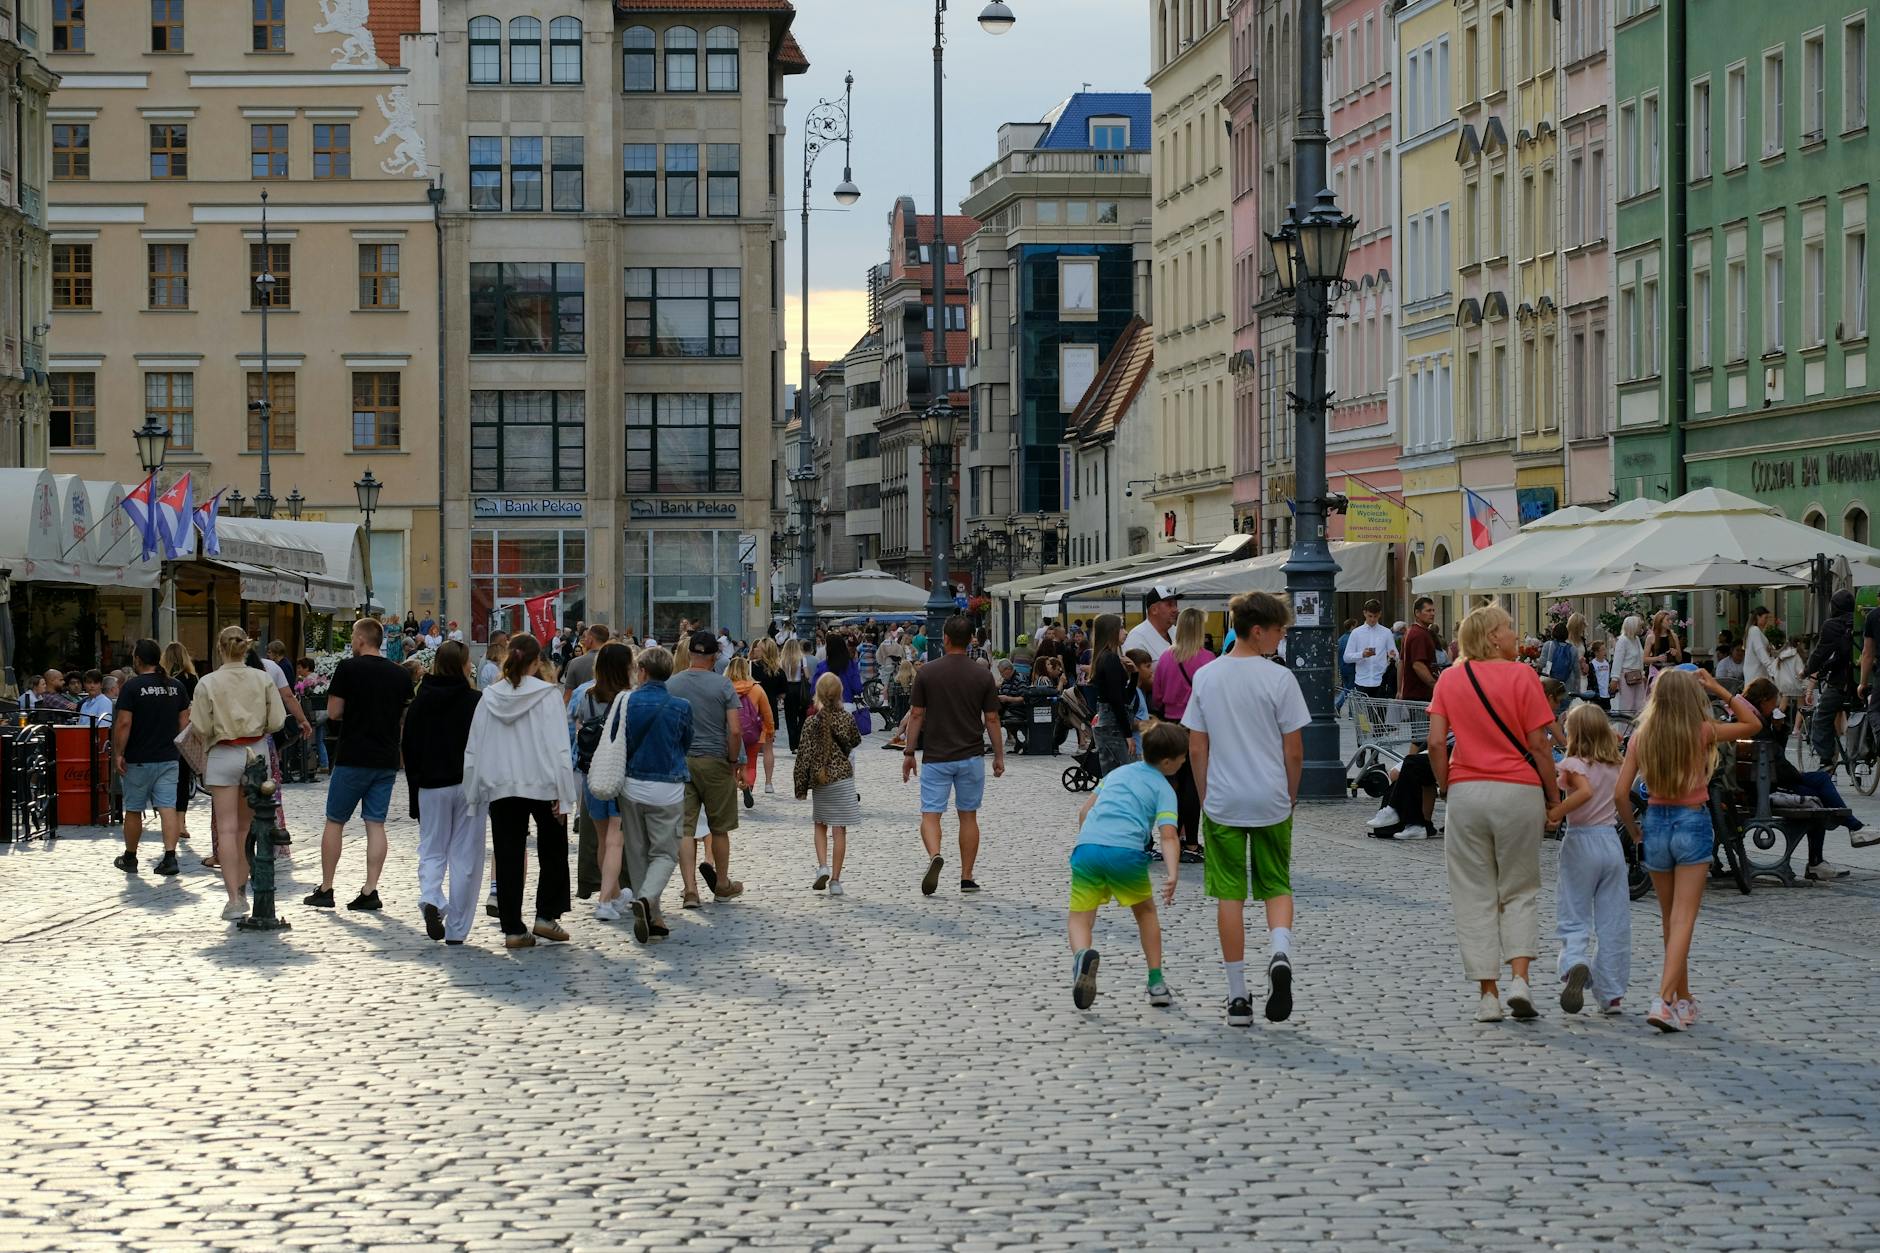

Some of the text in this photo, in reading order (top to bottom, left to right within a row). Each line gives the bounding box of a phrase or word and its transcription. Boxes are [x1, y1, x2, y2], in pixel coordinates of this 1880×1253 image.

[1801, 455, 1820, 488] BAR
[505, 499, 582, 513] Bank Pekao
[661, 500, 737, 513] Bank Pekao
[1349, 503, 1382, 511] Weekendy
[1357, 510, 1389, 518] Wycieczki
